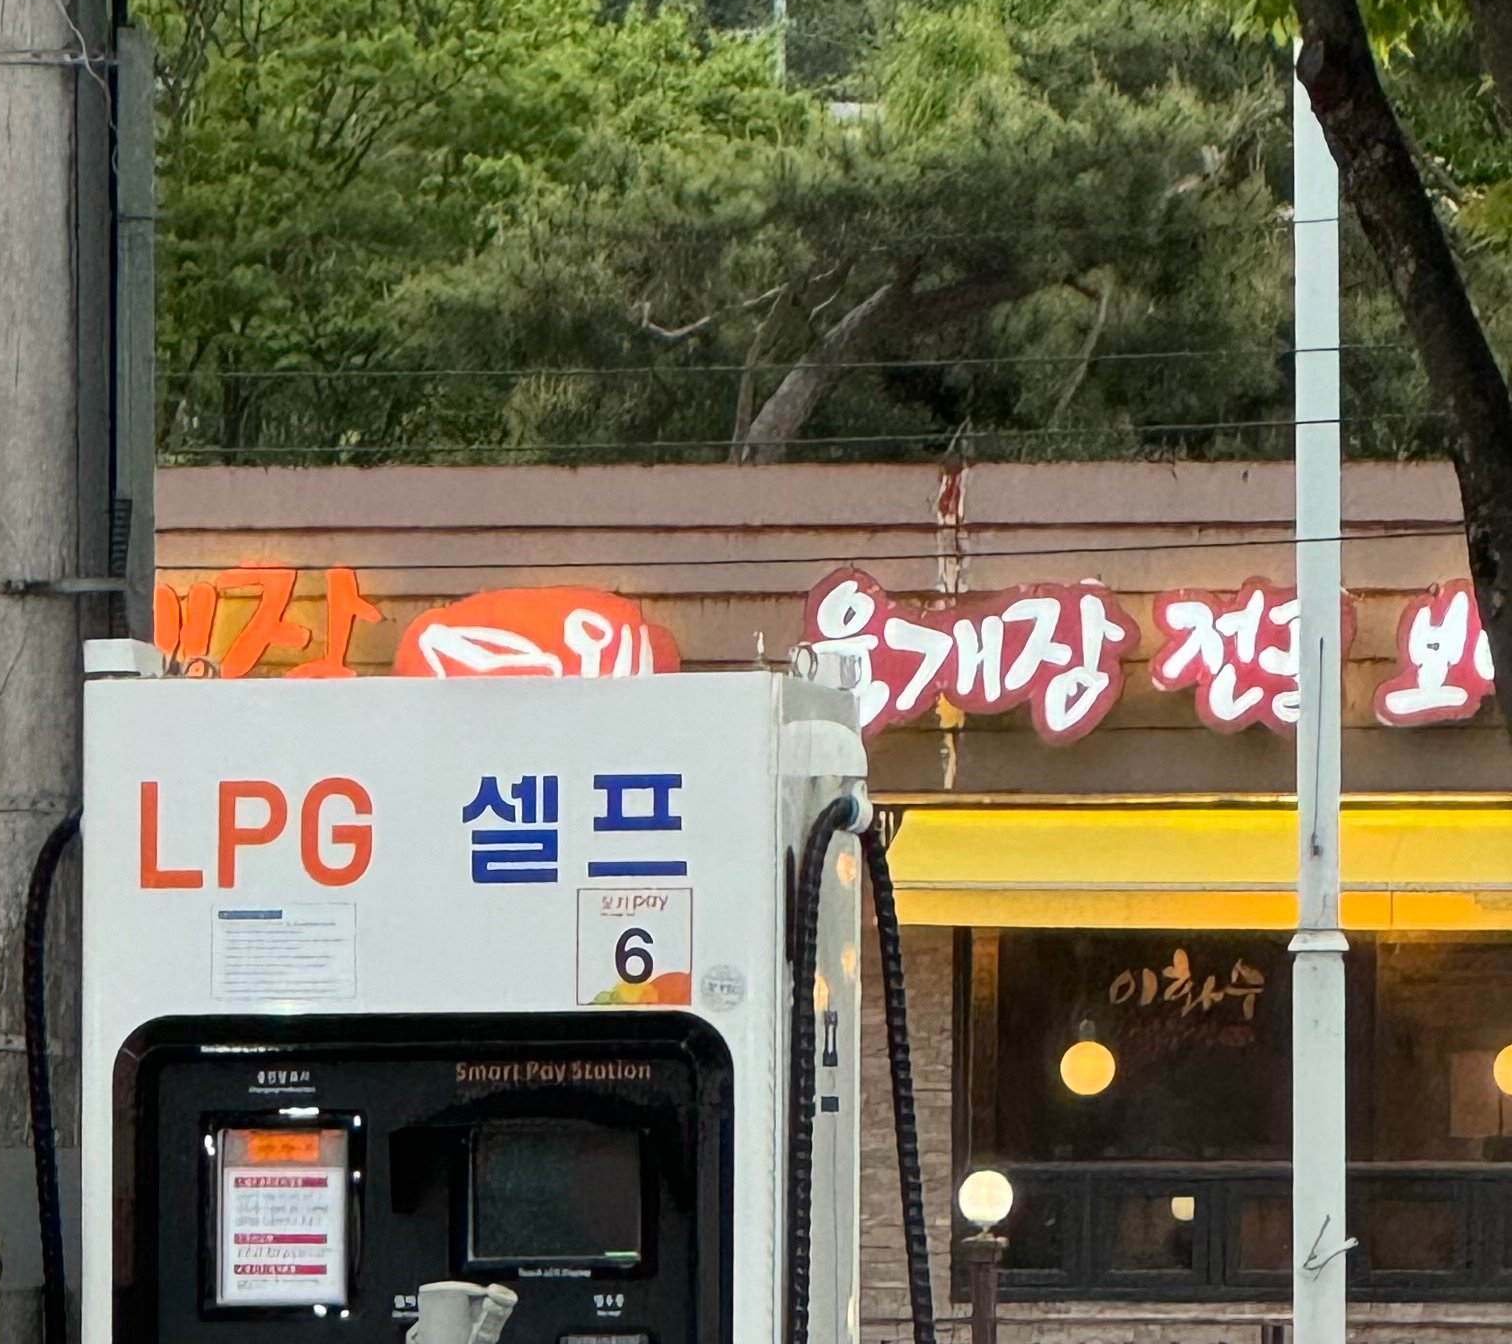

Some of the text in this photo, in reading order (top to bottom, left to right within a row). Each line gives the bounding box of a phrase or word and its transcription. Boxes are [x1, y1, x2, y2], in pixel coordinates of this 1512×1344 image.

[139, 777, 374, 889] LPG
[462, 774, 689, 884] 셀프
[615, 927, 654, 985] 6
[455, 1060, 652, 1085] Smart Pay Station
